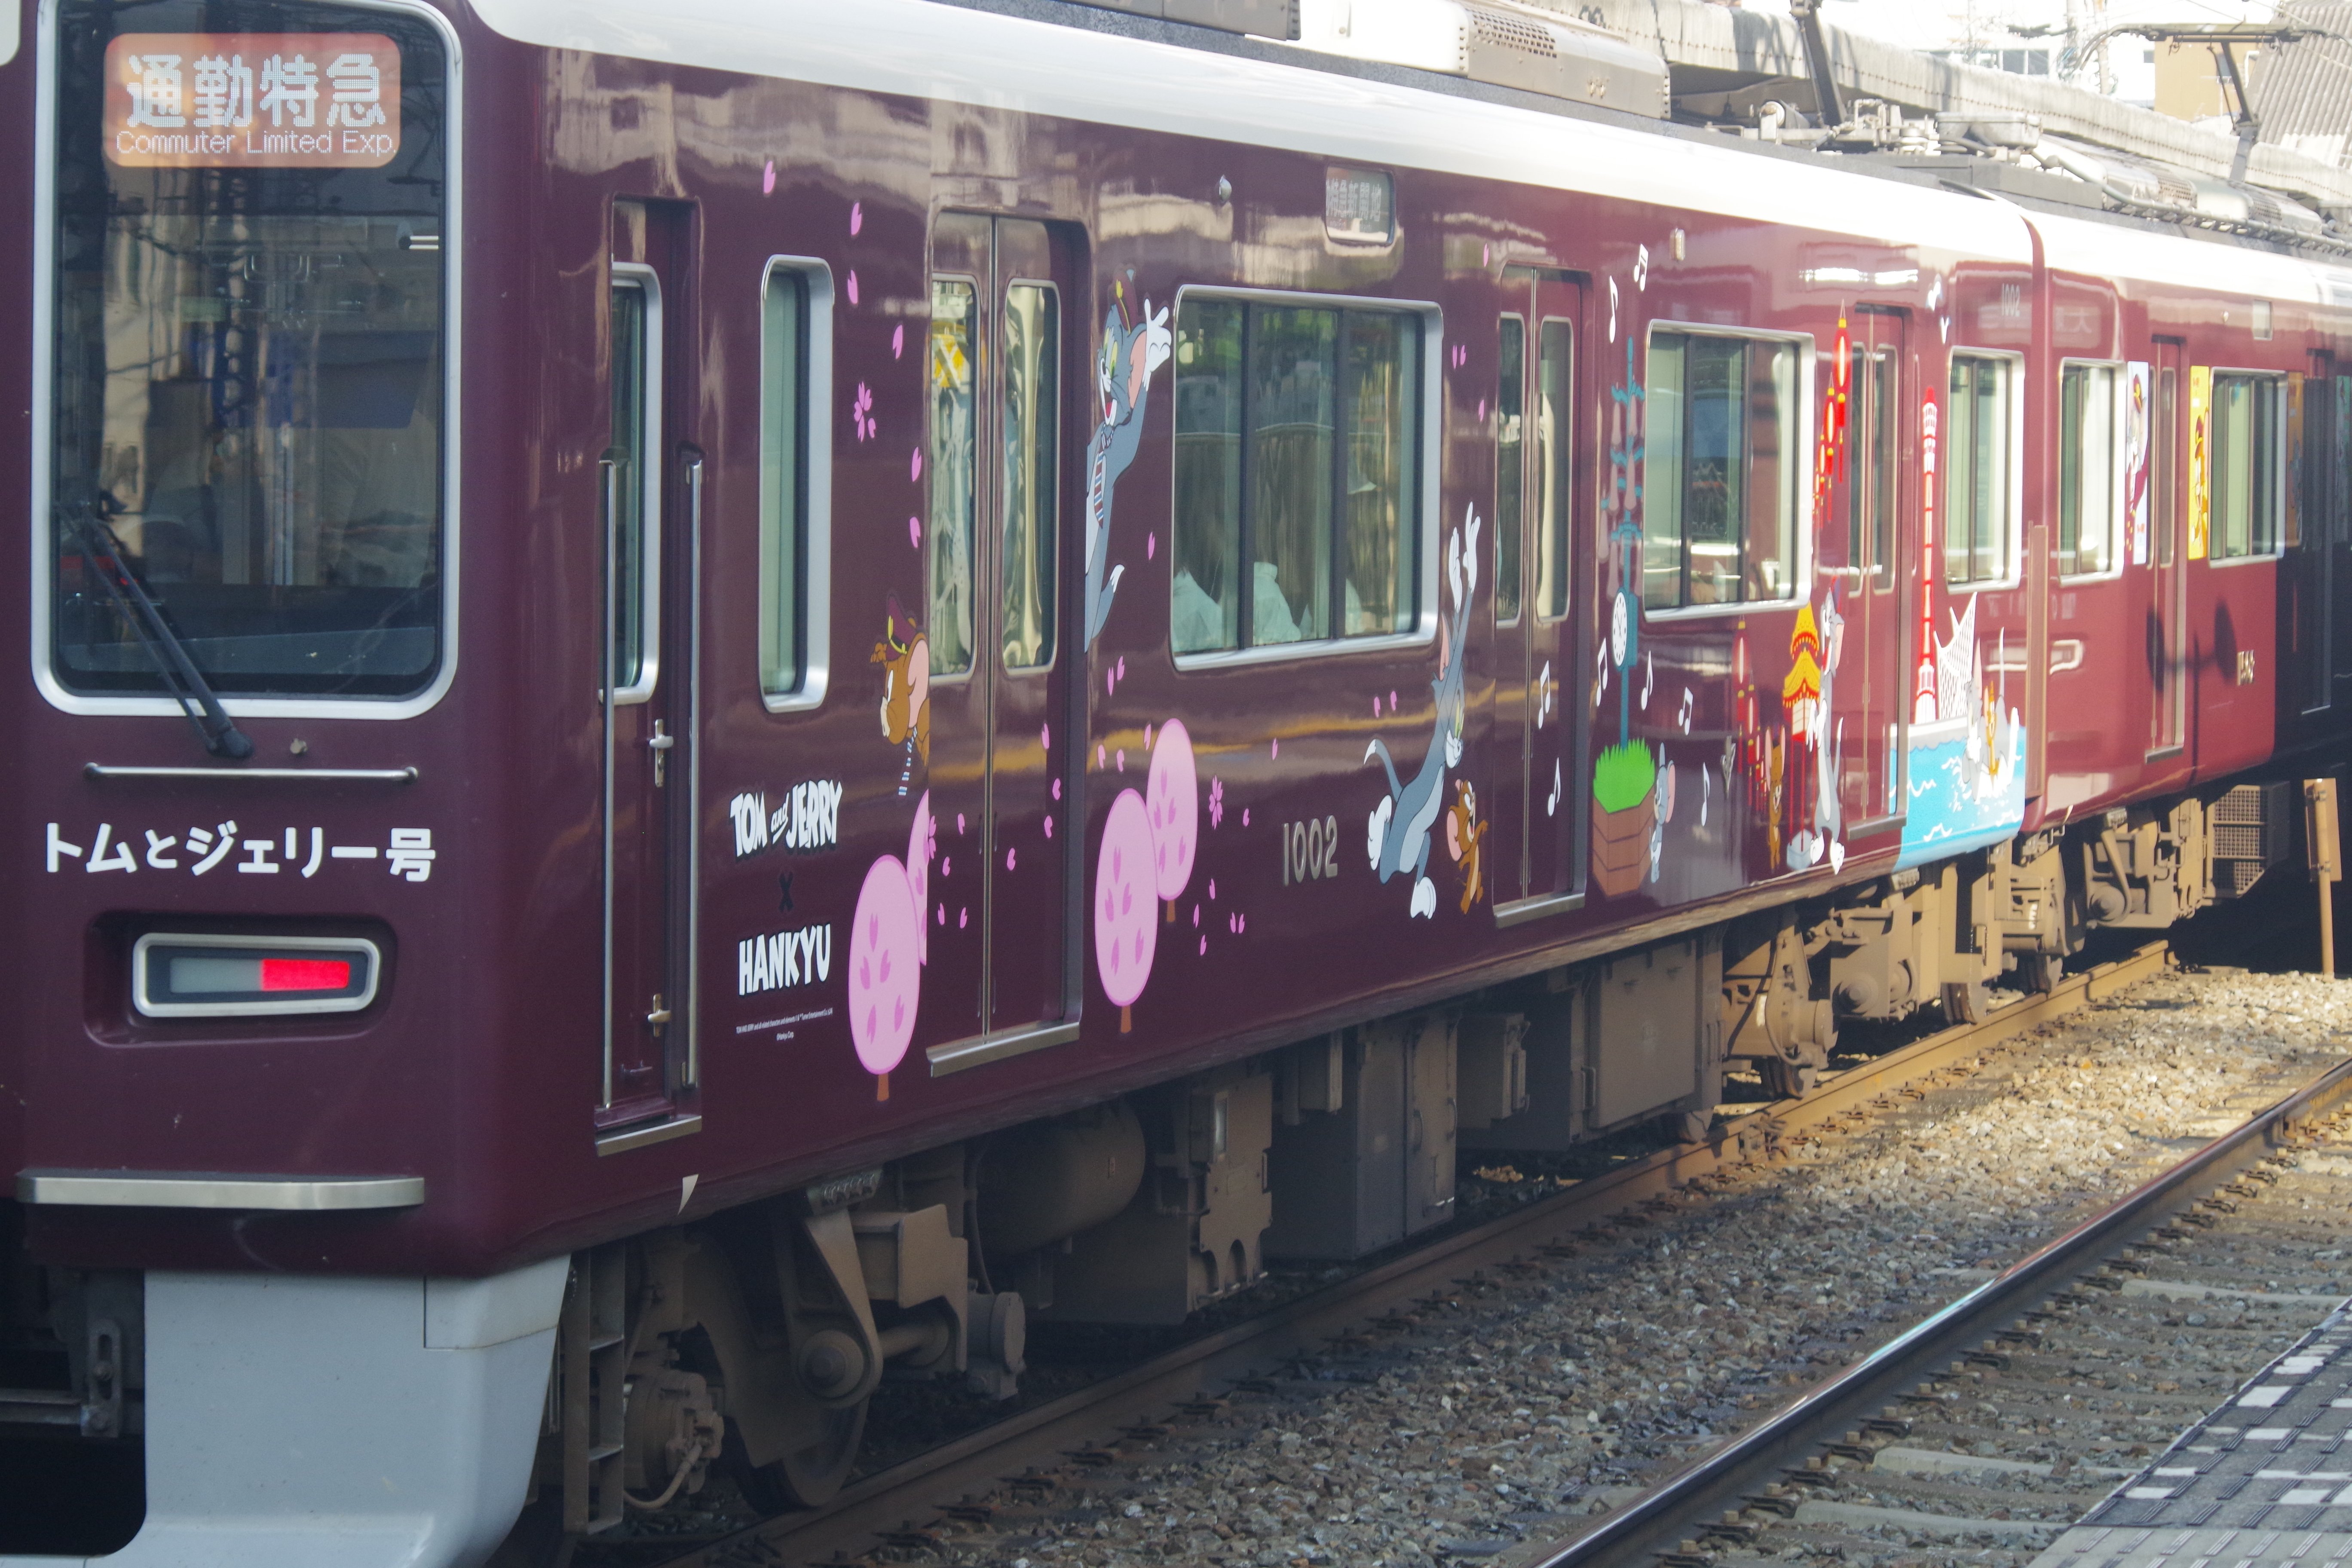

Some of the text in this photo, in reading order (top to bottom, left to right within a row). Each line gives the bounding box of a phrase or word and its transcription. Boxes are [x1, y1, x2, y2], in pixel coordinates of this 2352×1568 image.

[127, 54, 386, 127] 通勤特急
[116, 130, 396, 156] Commuter Limited Exp.
[2001, 282, 2020, 317] 1002
[46, 820, 436, 882] トムとジェリー号
[730, 790, 767, 858] TOM
[786, 779, 843, 849] JERRY
[1283, 815, 1338, 887] 1002
[738, 923, 831, 996] HANKYU
